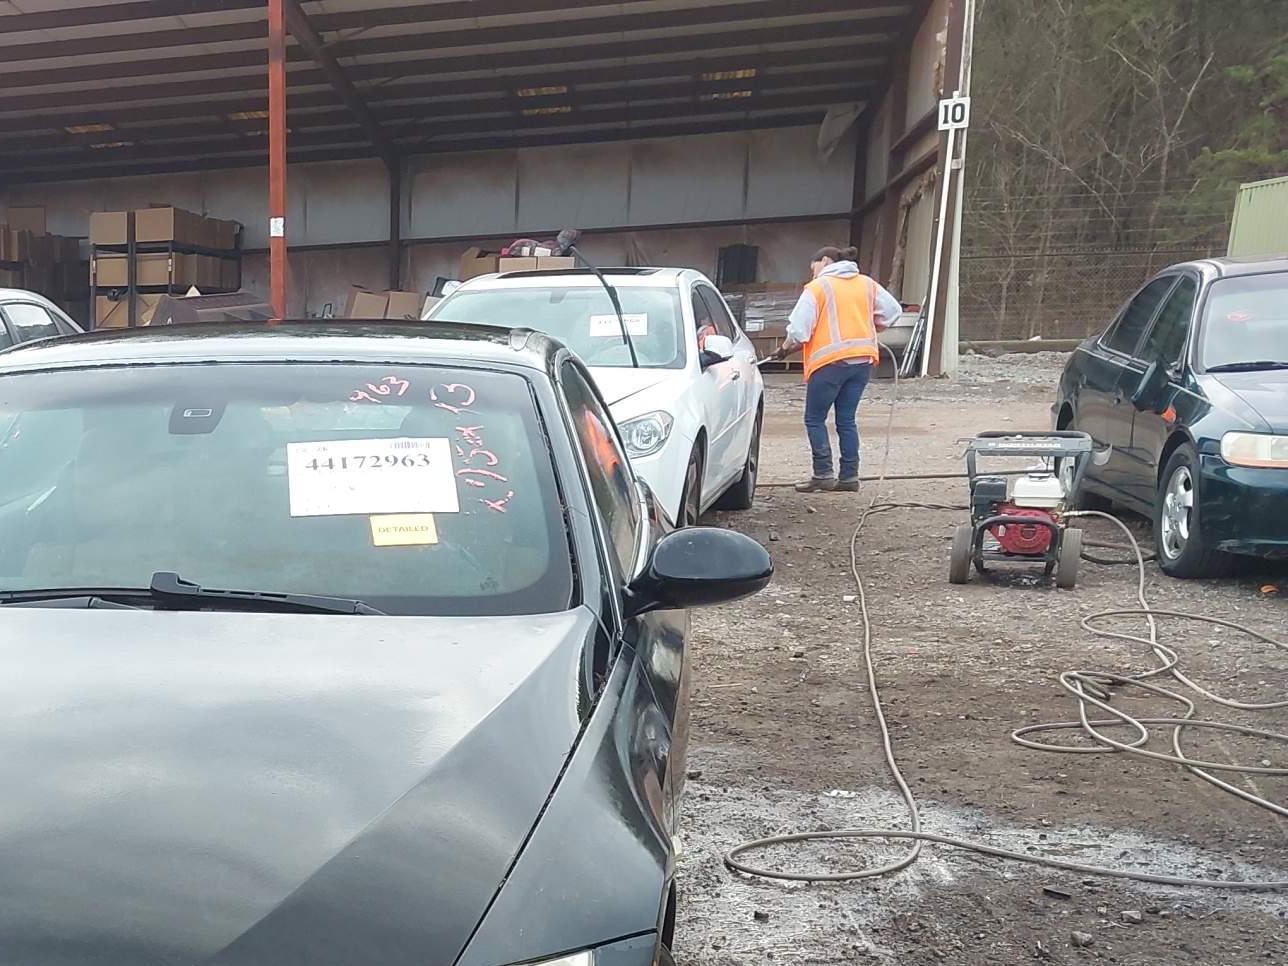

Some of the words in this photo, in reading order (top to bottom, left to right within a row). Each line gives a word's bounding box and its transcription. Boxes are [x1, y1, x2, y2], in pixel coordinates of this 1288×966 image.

[943, 103, 966, 124] 10
[305, 453, 431, 471] 44172963
[378, 525, 429, 533] DETAILED
